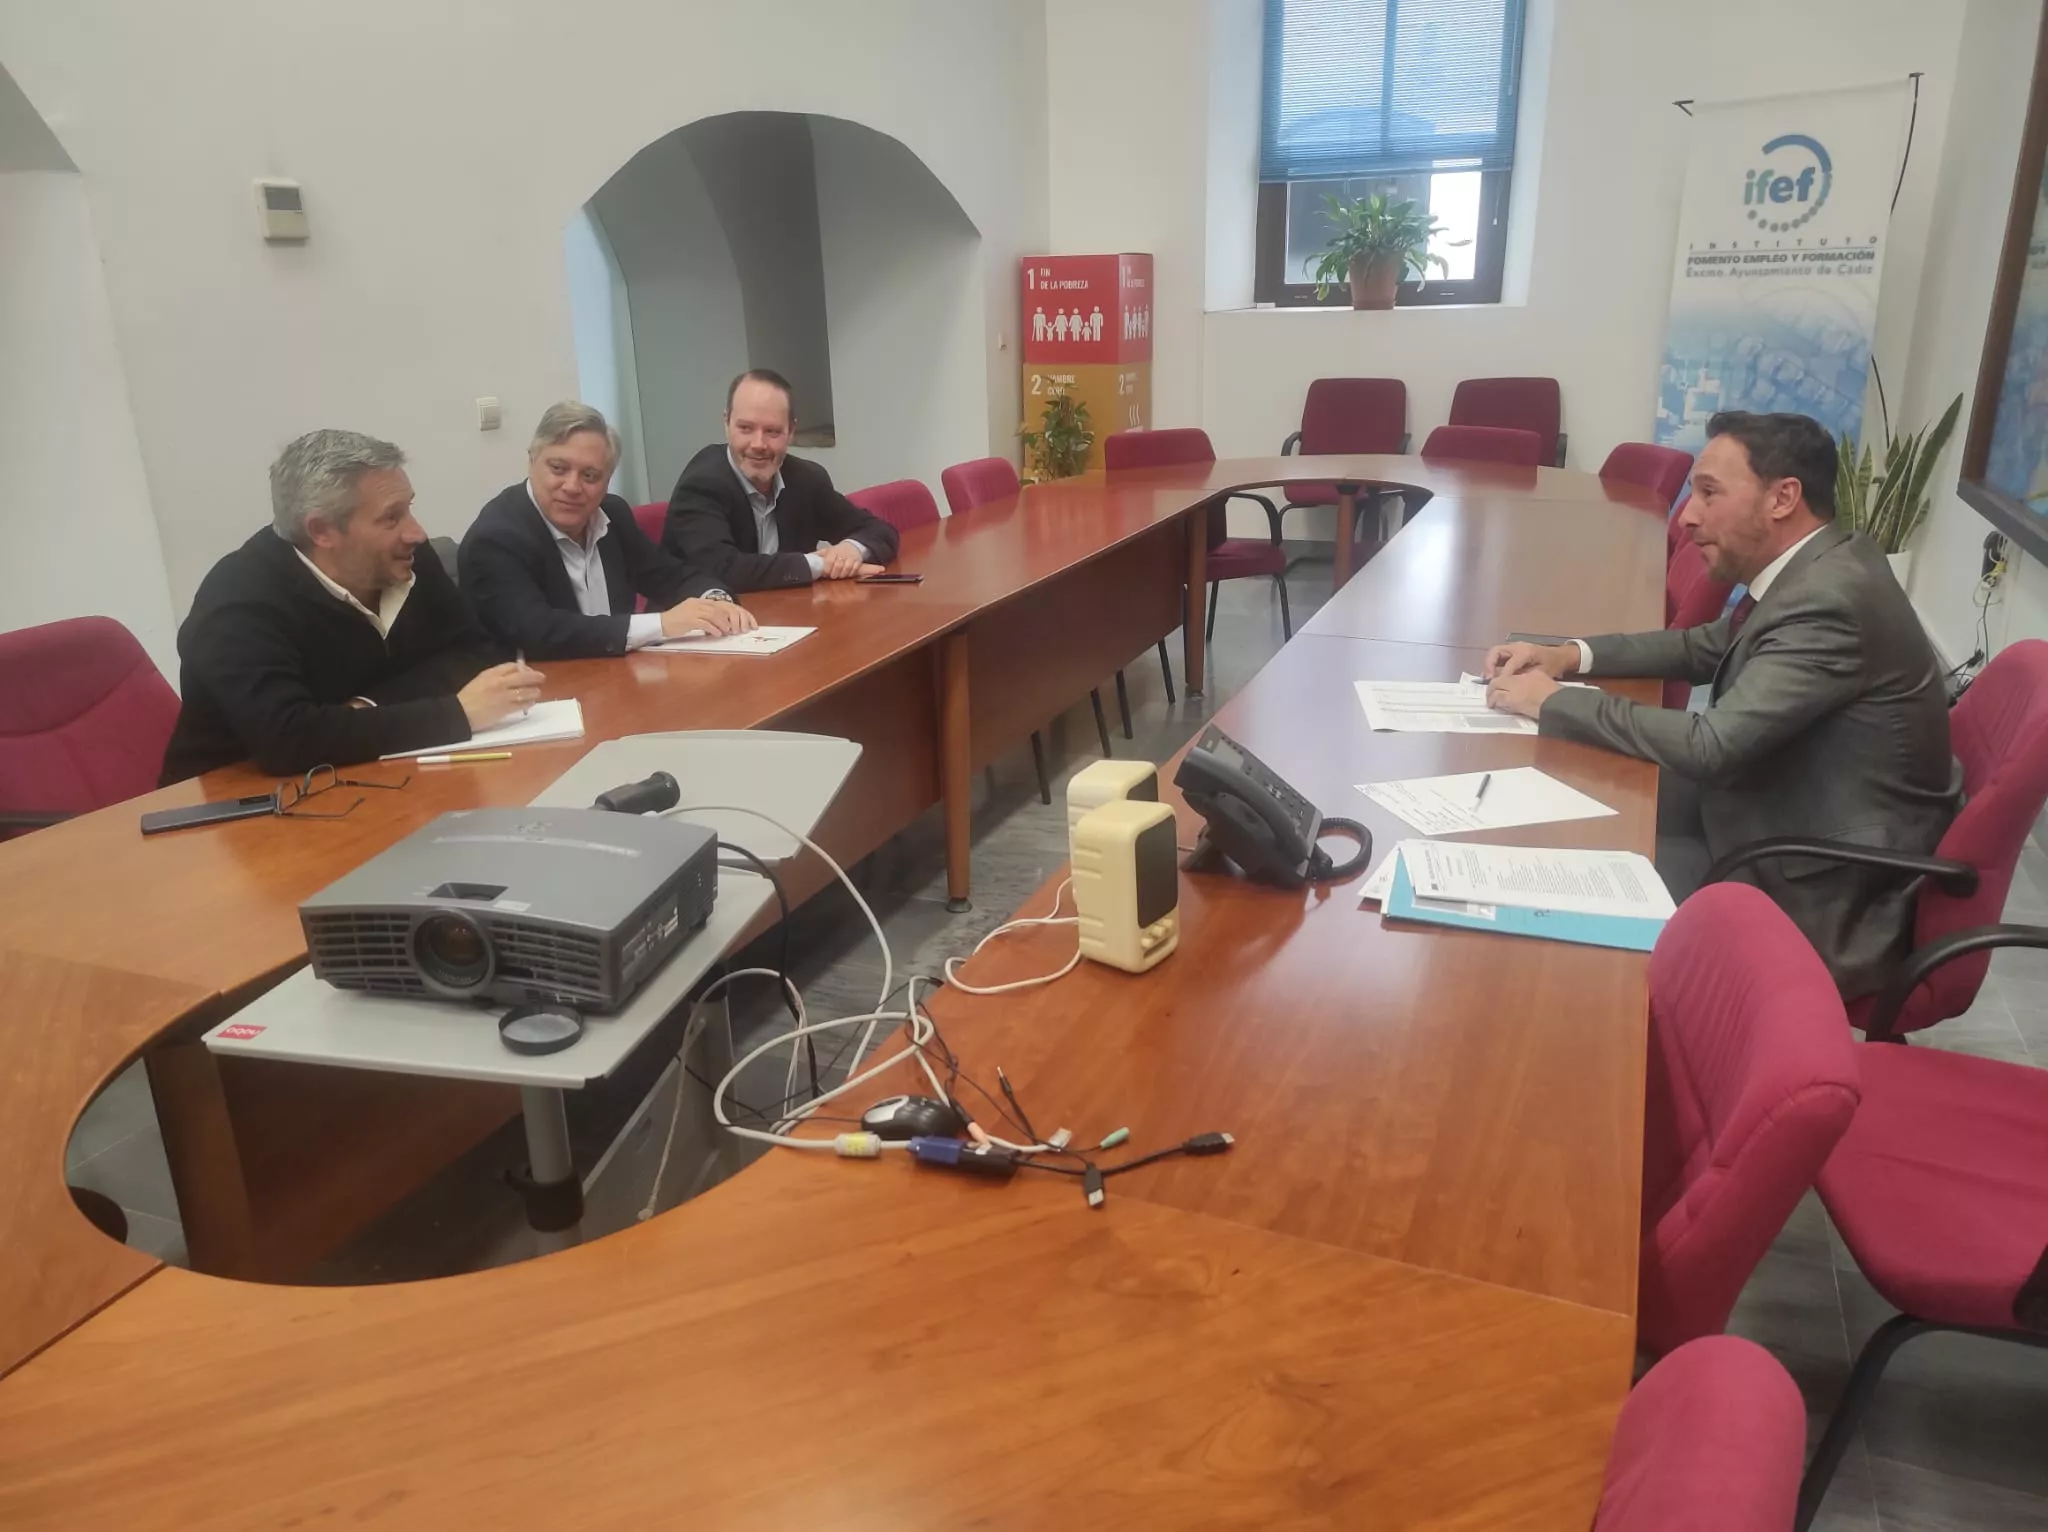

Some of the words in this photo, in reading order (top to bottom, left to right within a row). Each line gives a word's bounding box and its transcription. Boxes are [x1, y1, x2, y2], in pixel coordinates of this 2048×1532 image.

[1744, 166, 1816, 206] ifef
[1689, 236, 1878, 250] INSTITUTO
[1688, 255, 1741, 265] FOMENTO
[1743, 254, 1787, 263] EMPLEO
[1791, 253, 1799, 262] Y
[1801, 250, 1874, 262] FORMACIÓN
[1027, 268, 1035, 290] 1
[1040, 268, 1051, 277] FIN
[1040, 281, 1049, 290] DE
[1050, 280, 1058, 289] LA
[1059, 280, 1089, 289] POBREZA
[1031, 374, 1042, 395] 2
